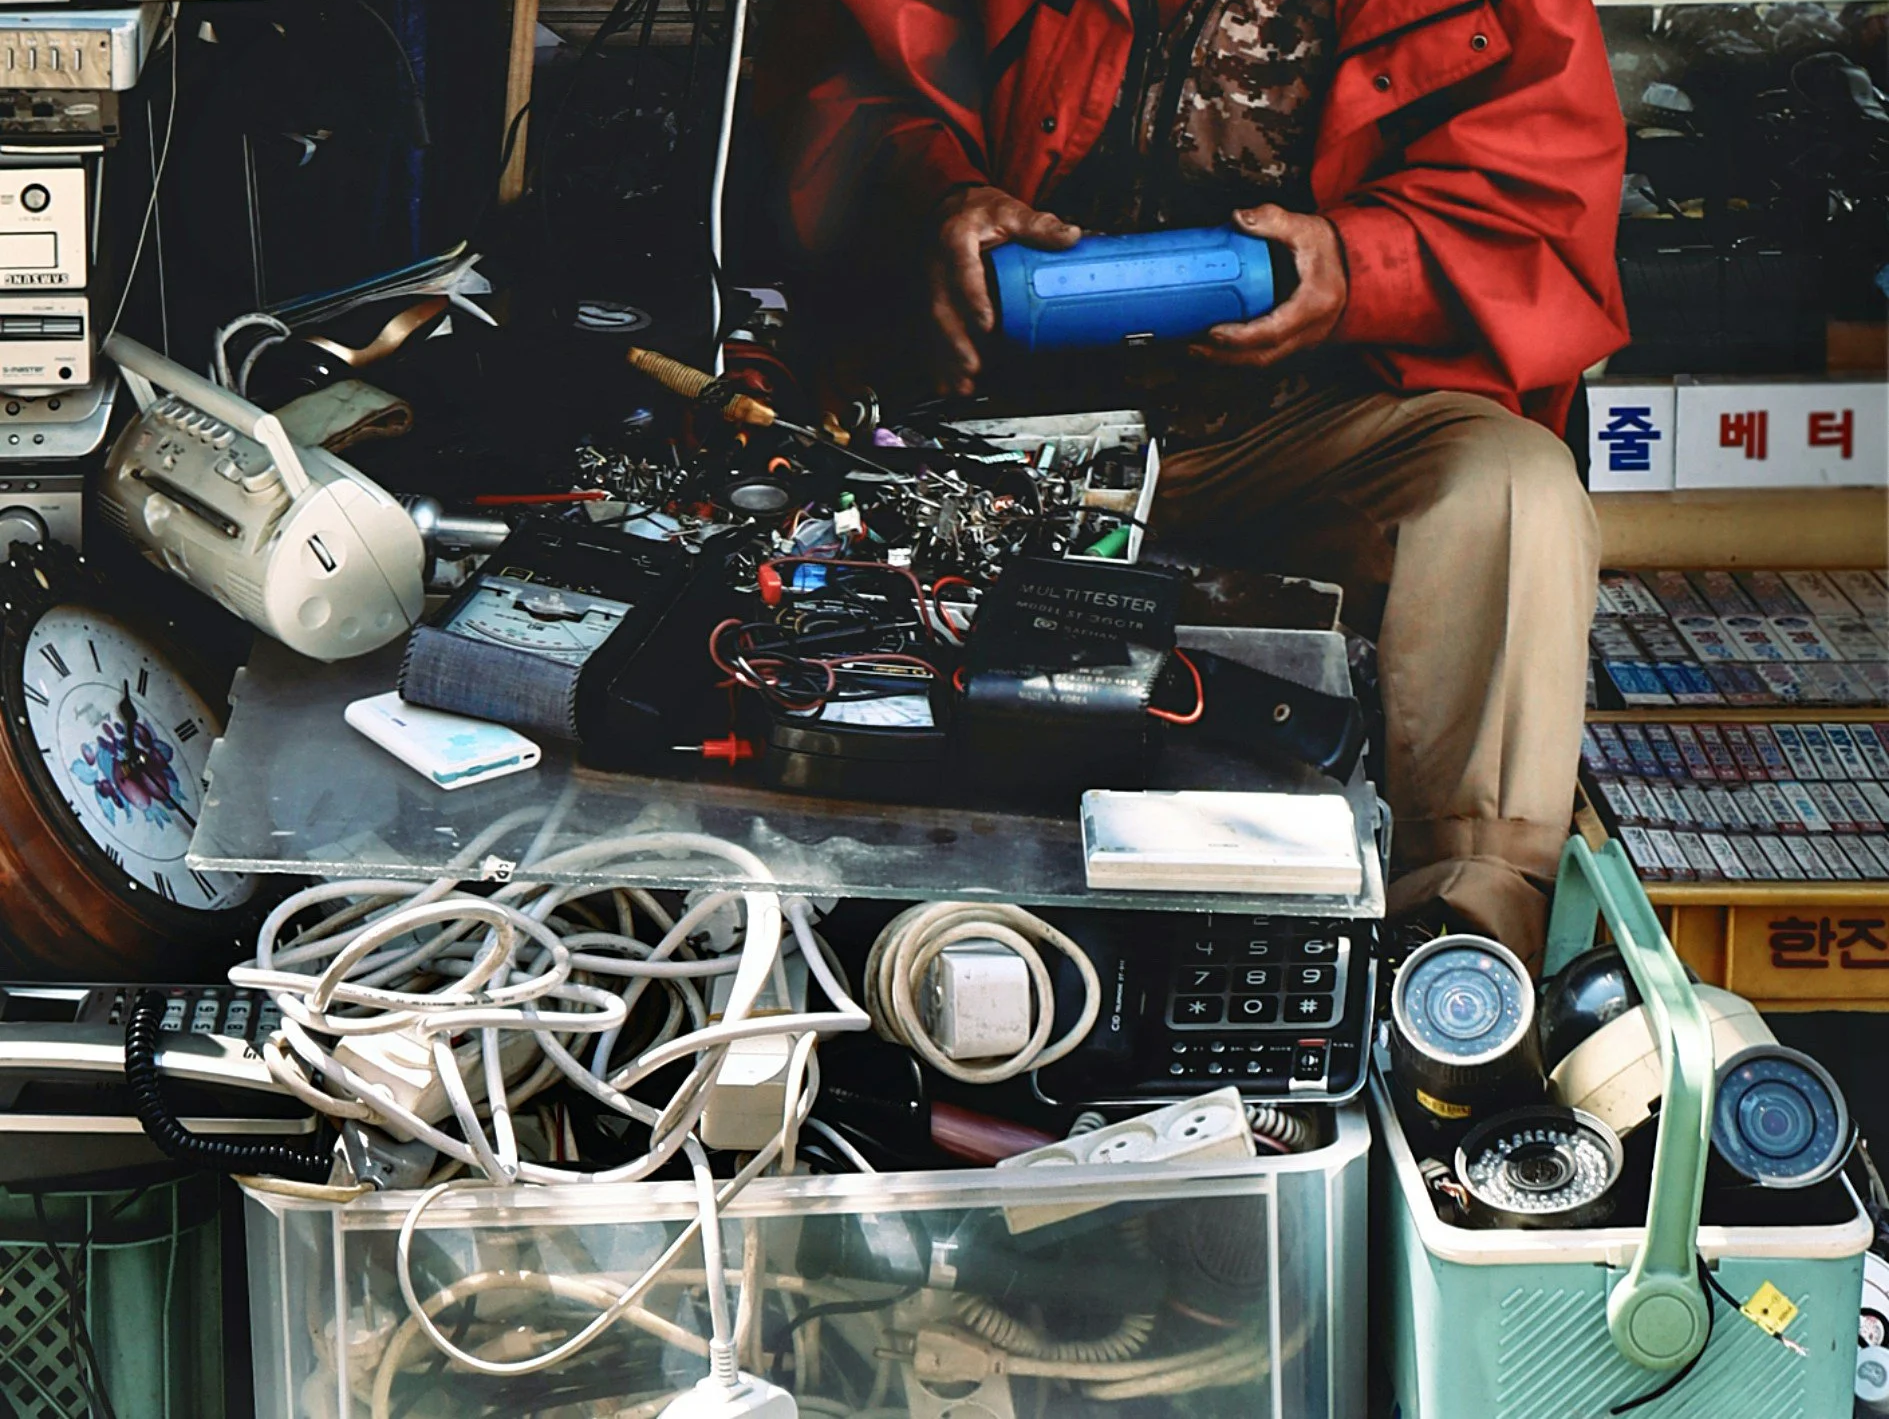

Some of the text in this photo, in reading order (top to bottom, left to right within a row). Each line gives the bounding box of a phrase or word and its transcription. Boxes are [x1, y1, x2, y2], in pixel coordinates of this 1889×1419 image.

[5, 272, 69, 285] SAMSUNG
[1597, 407, 1660, 471] 줄
[1019, 583, 1158, 614] MULTITESTER
[1196, 940, 1324, 955] 4 5 6
[1194, 968, 1321, 986] 7 8 9
